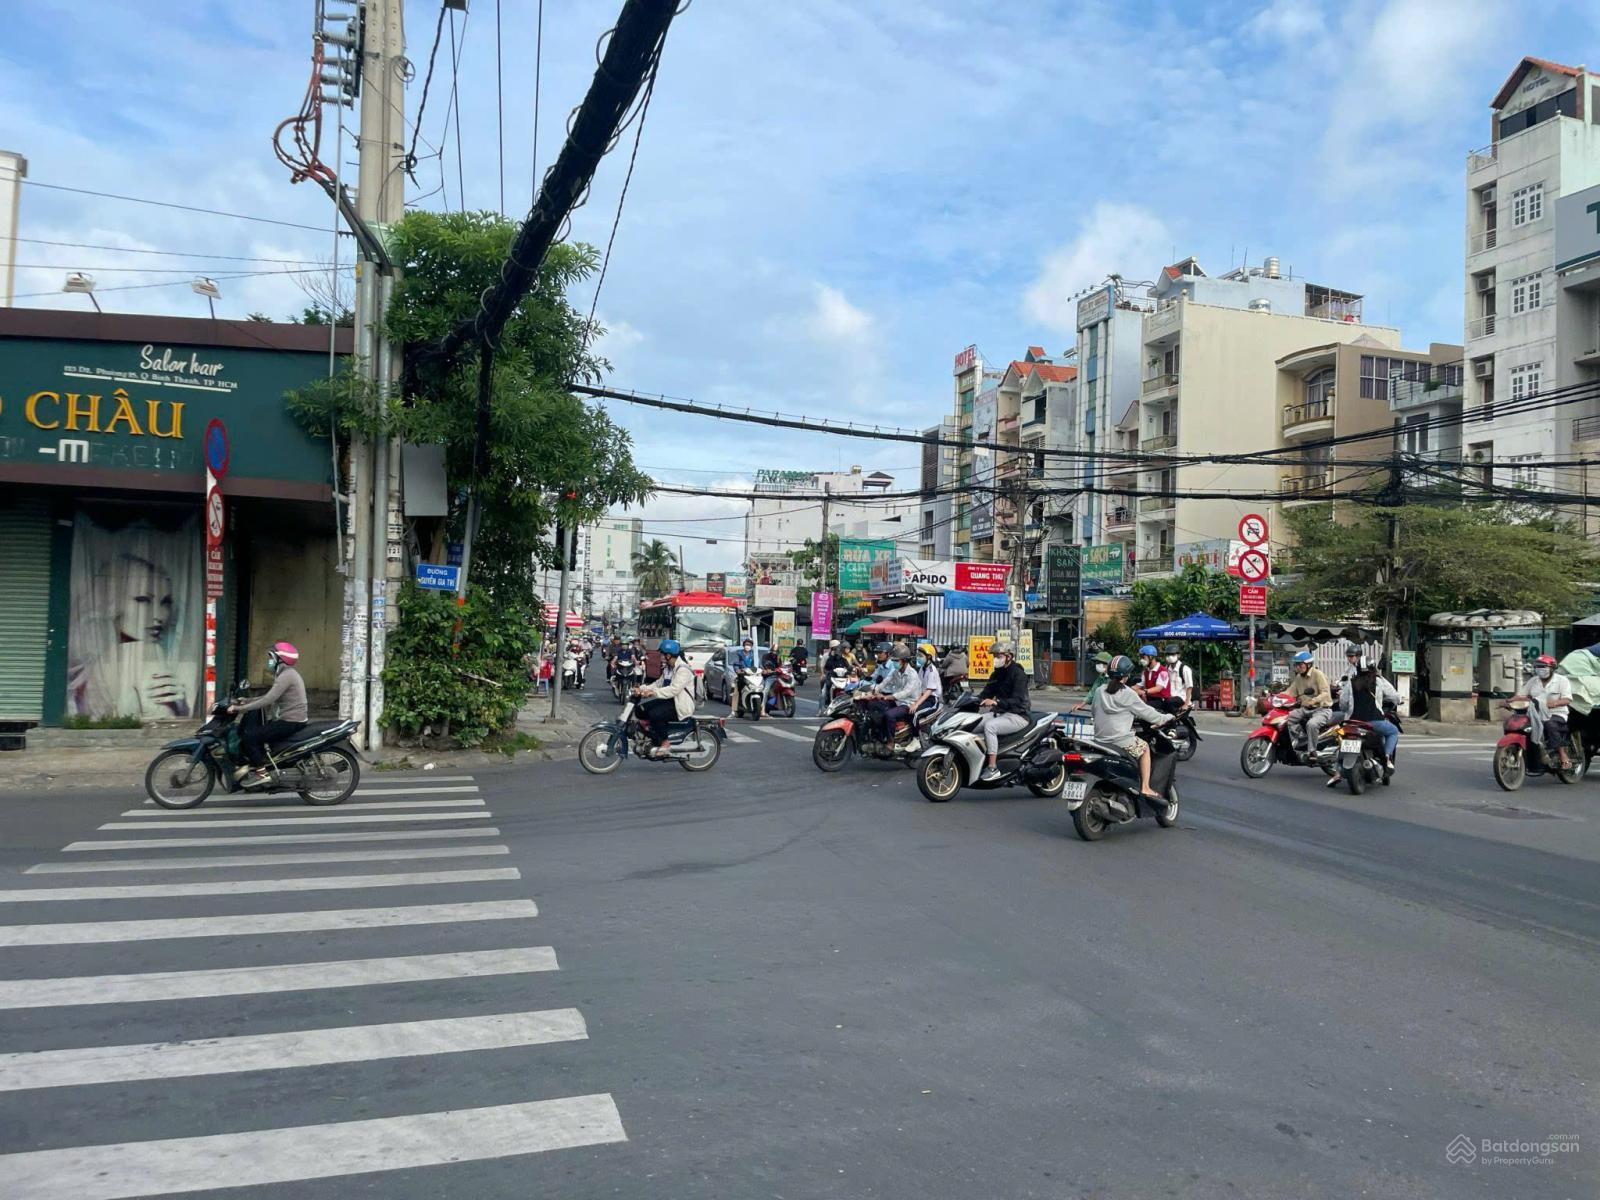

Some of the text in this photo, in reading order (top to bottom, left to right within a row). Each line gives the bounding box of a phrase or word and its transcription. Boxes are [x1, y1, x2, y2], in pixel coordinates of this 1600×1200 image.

[140, 344, 224, 376] Salon hair
[25, 388, 185, 439] CHÂU
